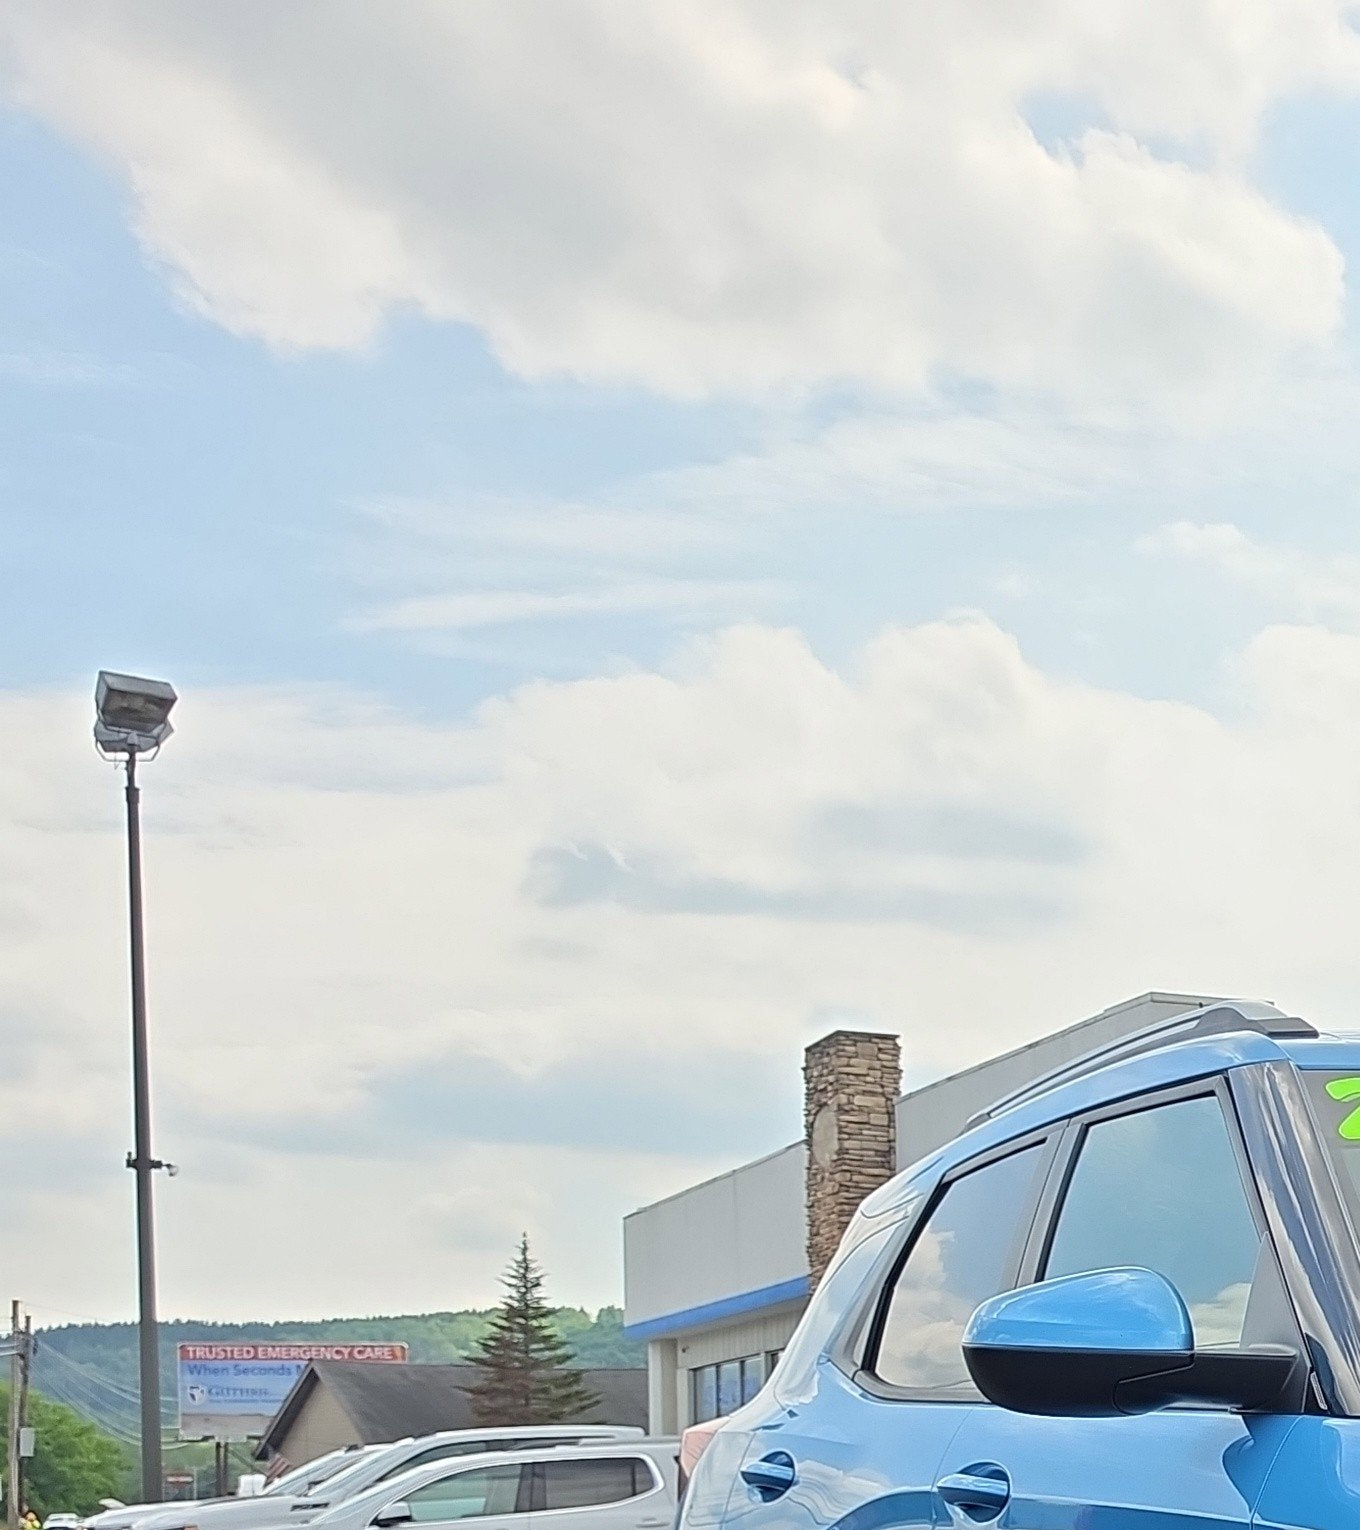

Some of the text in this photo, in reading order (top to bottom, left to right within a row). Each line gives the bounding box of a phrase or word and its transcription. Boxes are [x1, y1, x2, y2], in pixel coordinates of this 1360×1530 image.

[187, 1346, 393, 1360] TRUSTED EMERGENCY CARE
[188, 1364, 229, 1377] When
[233, 1363, 292, 1377] Seconds
